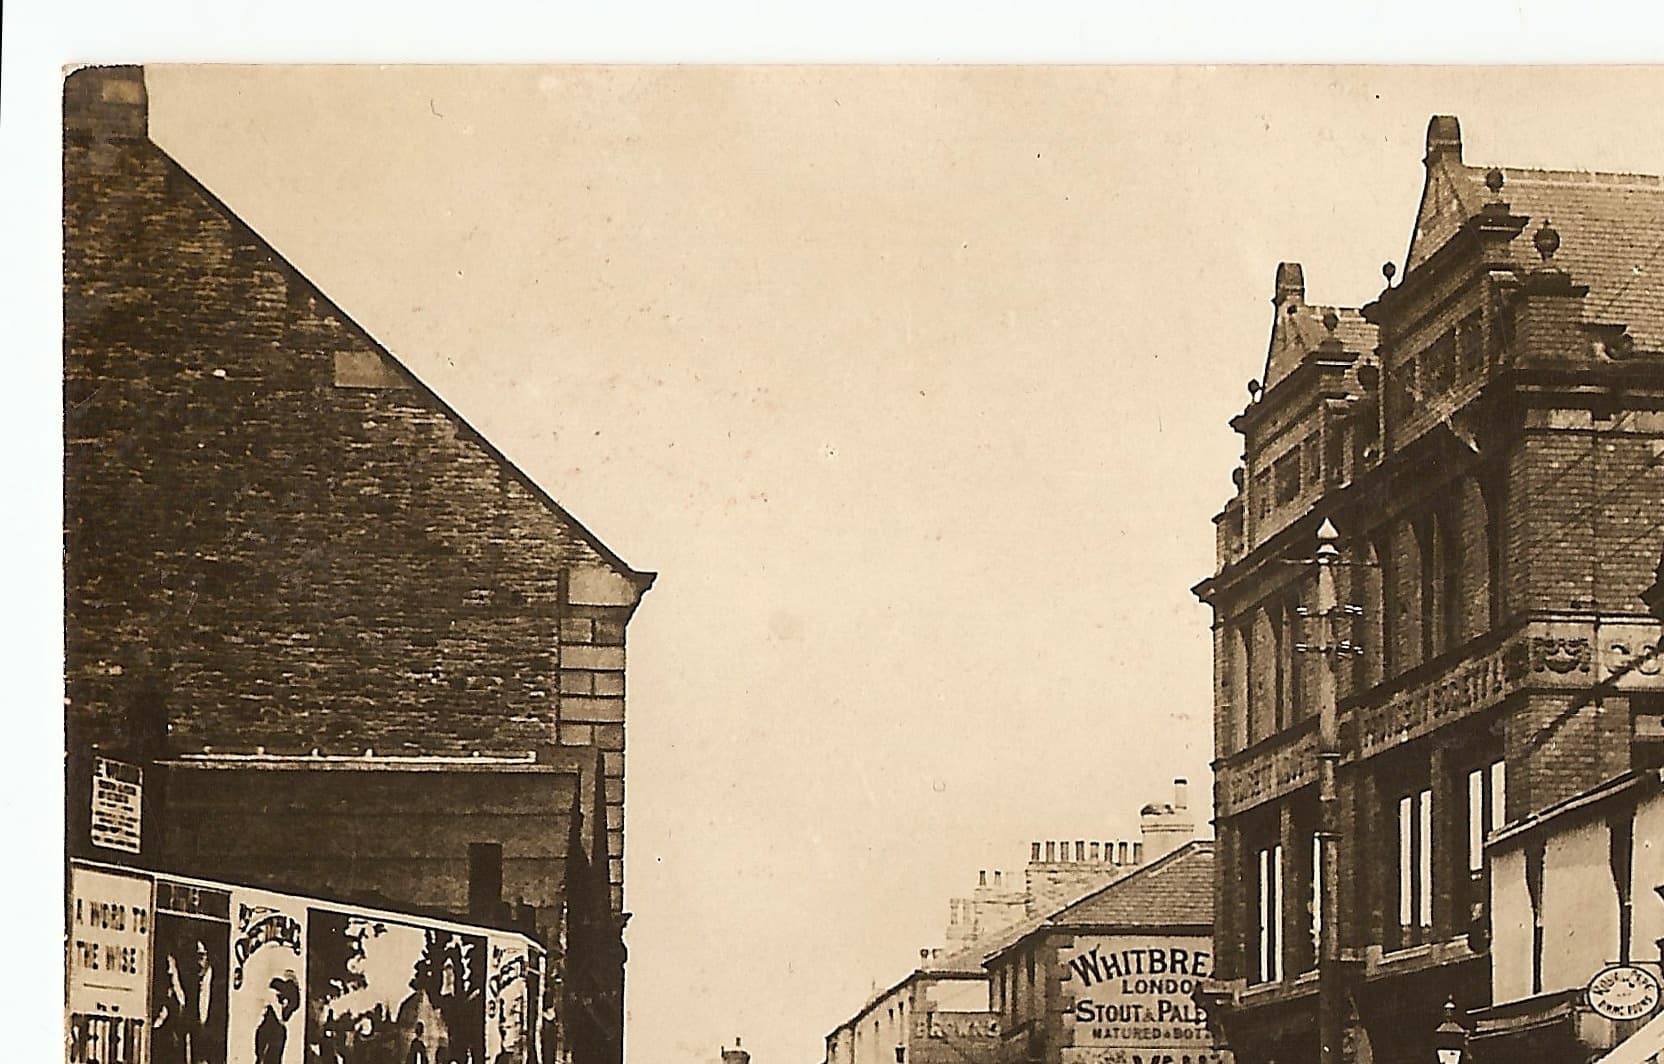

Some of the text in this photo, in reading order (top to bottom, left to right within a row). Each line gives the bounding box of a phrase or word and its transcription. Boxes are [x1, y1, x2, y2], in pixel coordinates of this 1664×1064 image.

[1069, 943, 1214, 988] WHITBRE
[1121, 979, 1203, 995] LONDO
[1076, 999, 1144, 1023] STOUT
[1092, 1027, 1162, 1040] MATURED
